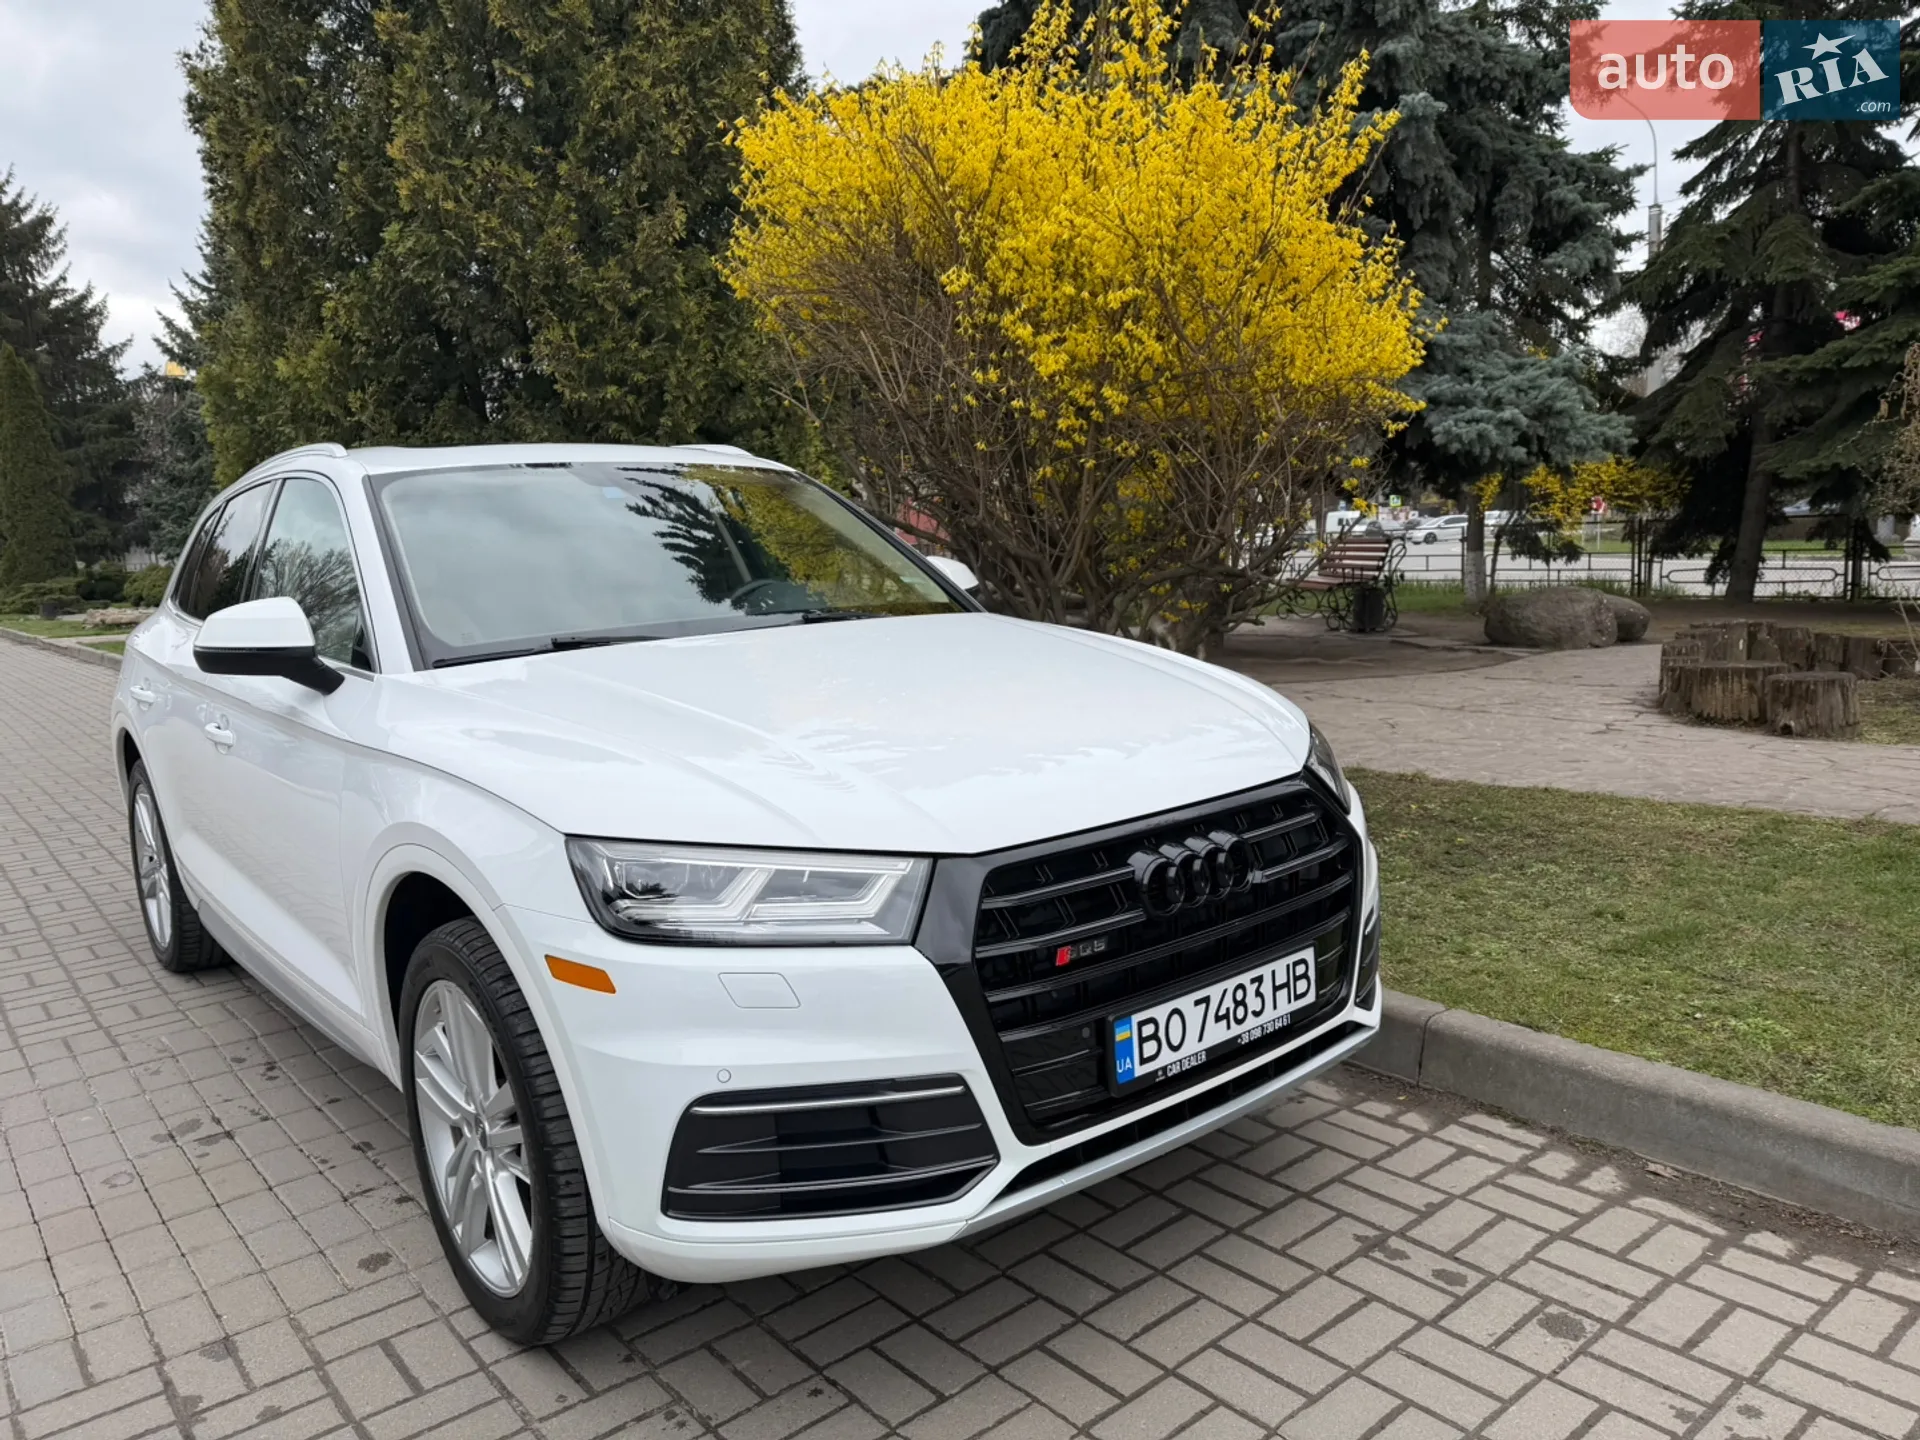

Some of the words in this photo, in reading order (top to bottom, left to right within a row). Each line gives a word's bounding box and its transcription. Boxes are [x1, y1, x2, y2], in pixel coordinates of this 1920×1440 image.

[1136, 1007, 1187, 1067] BO
[1193, 974, 1266, 1043] 7483
[1271, 957, 1312, 1011] HB
[1116, 1056, 1133, 1073] UA
[1166, 1060, 1181, 1077] CAR
[1181, 1050, 1207, 1071] DEALER
